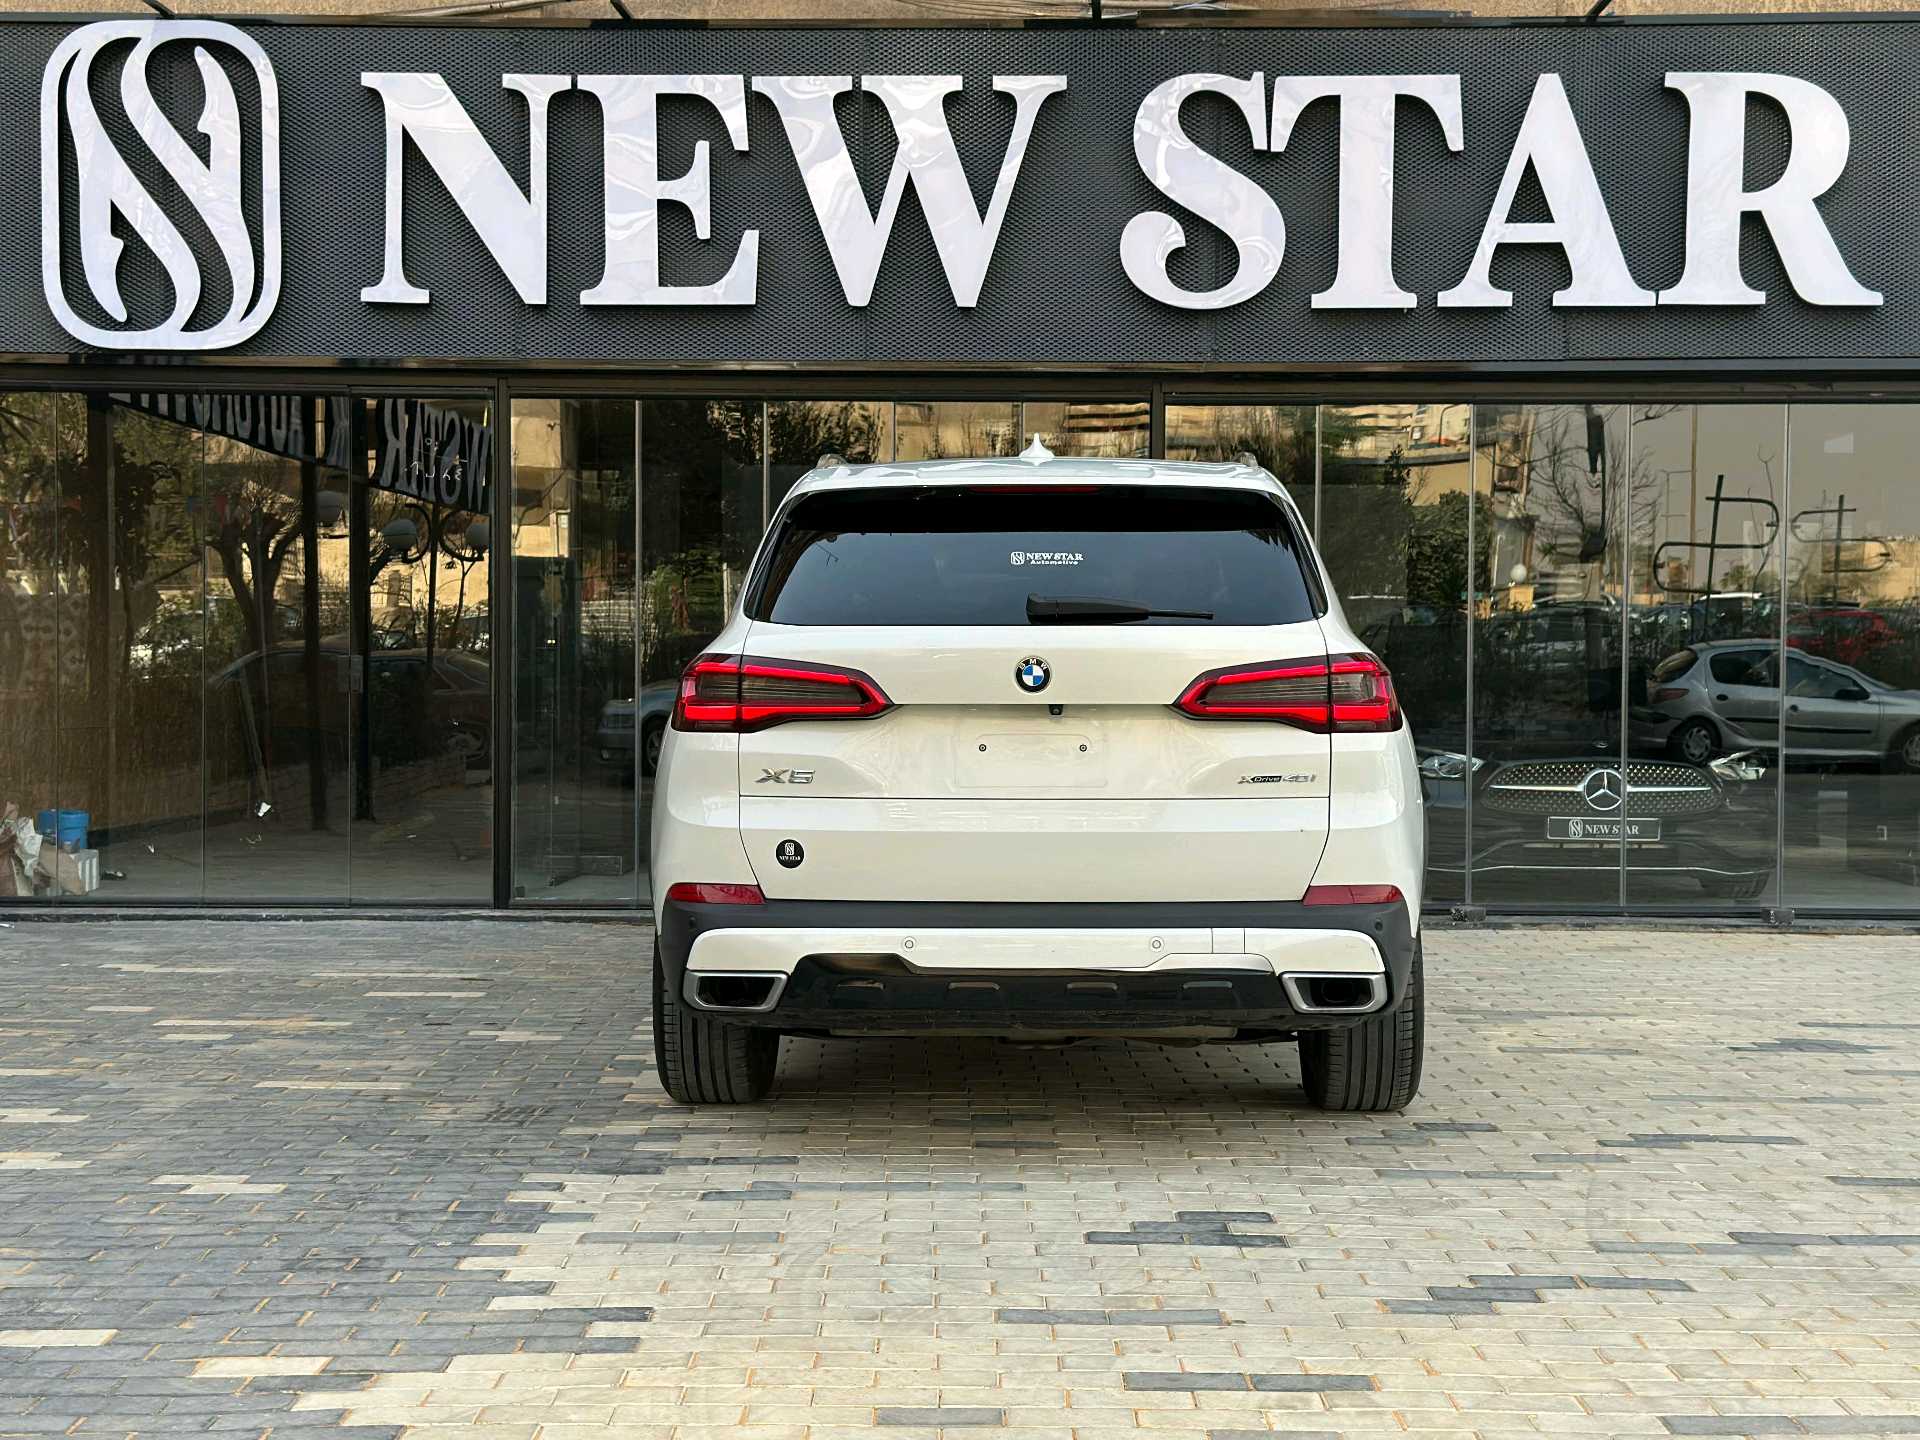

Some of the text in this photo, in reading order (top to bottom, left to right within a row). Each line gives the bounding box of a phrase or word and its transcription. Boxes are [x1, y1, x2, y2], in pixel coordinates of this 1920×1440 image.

[361, 71, 1883, 309] NEW STAR
[1026, 552, 1083, 560] NEW STAR
[755, 767, 816, 784] X5
[1585, 824, 1640, 835] NEW SAR
